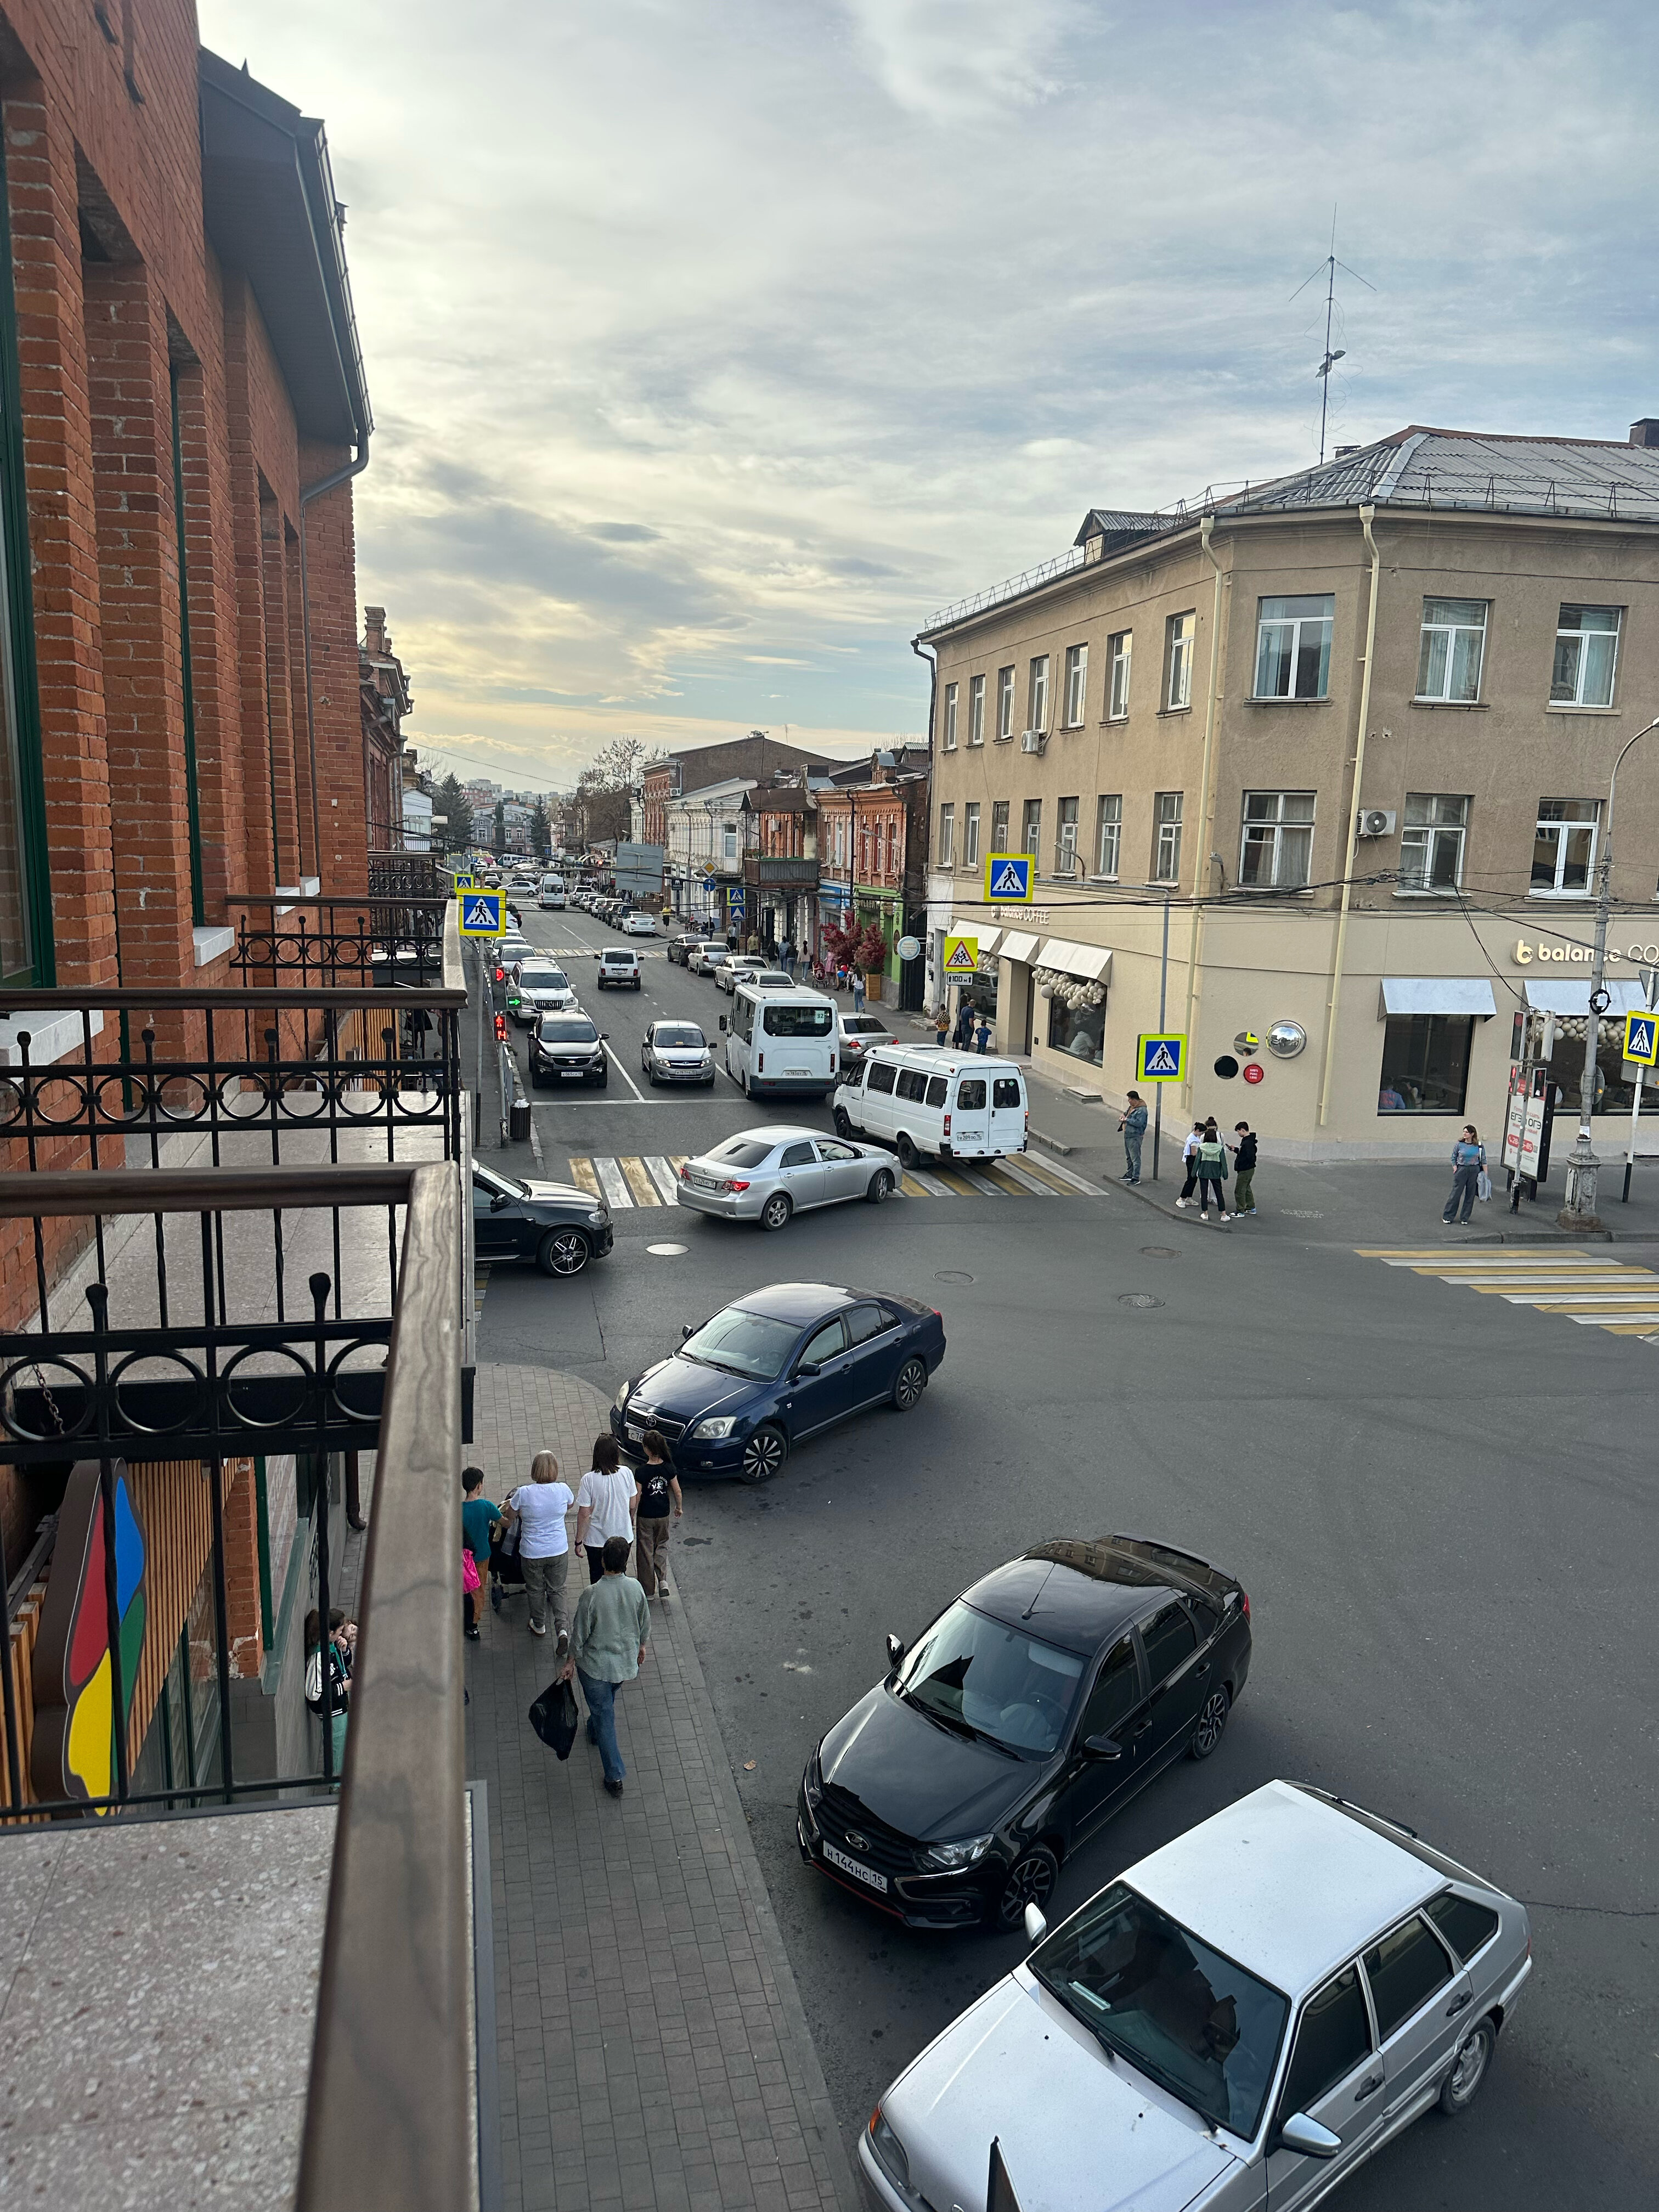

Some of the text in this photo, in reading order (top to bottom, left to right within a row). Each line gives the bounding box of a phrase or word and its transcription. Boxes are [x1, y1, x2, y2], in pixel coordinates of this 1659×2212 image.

[1024, 907, 1049, 924] COFFEE
[1538, 943, 1622, 962] balane
[497, 1030, 507, 1040] 14
[1511, 1111, 1542, 1130] ЕГЭ ОГЭ
[872, 1874, 883, 1885] 15
